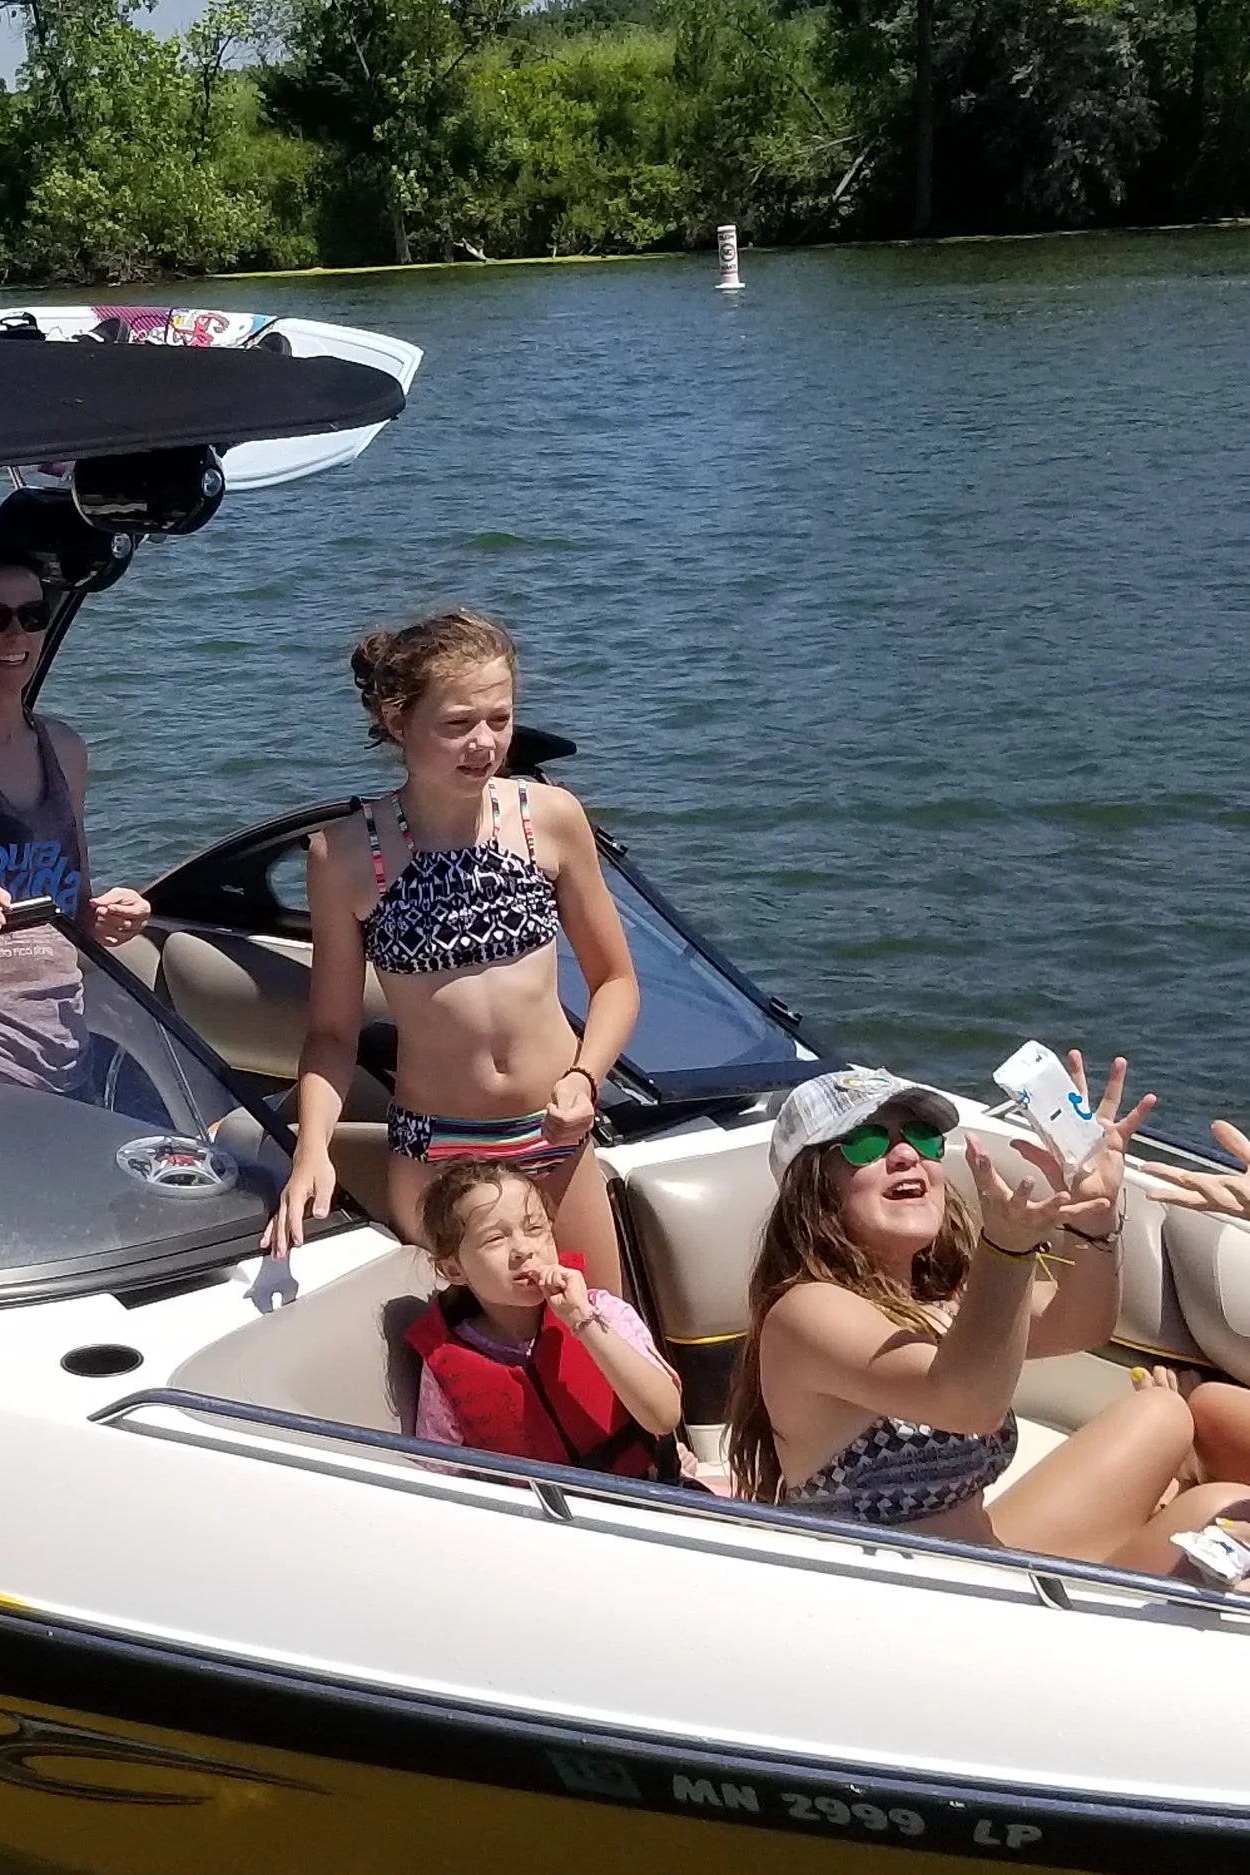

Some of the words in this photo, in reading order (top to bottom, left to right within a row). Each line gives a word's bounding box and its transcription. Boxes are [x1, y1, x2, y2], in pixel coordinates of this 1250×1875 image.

[672, 1774, 761, 1814] MN
[781, 1792, 926, 1836] 2999
[972, 1819, 1043, 1850] LP
